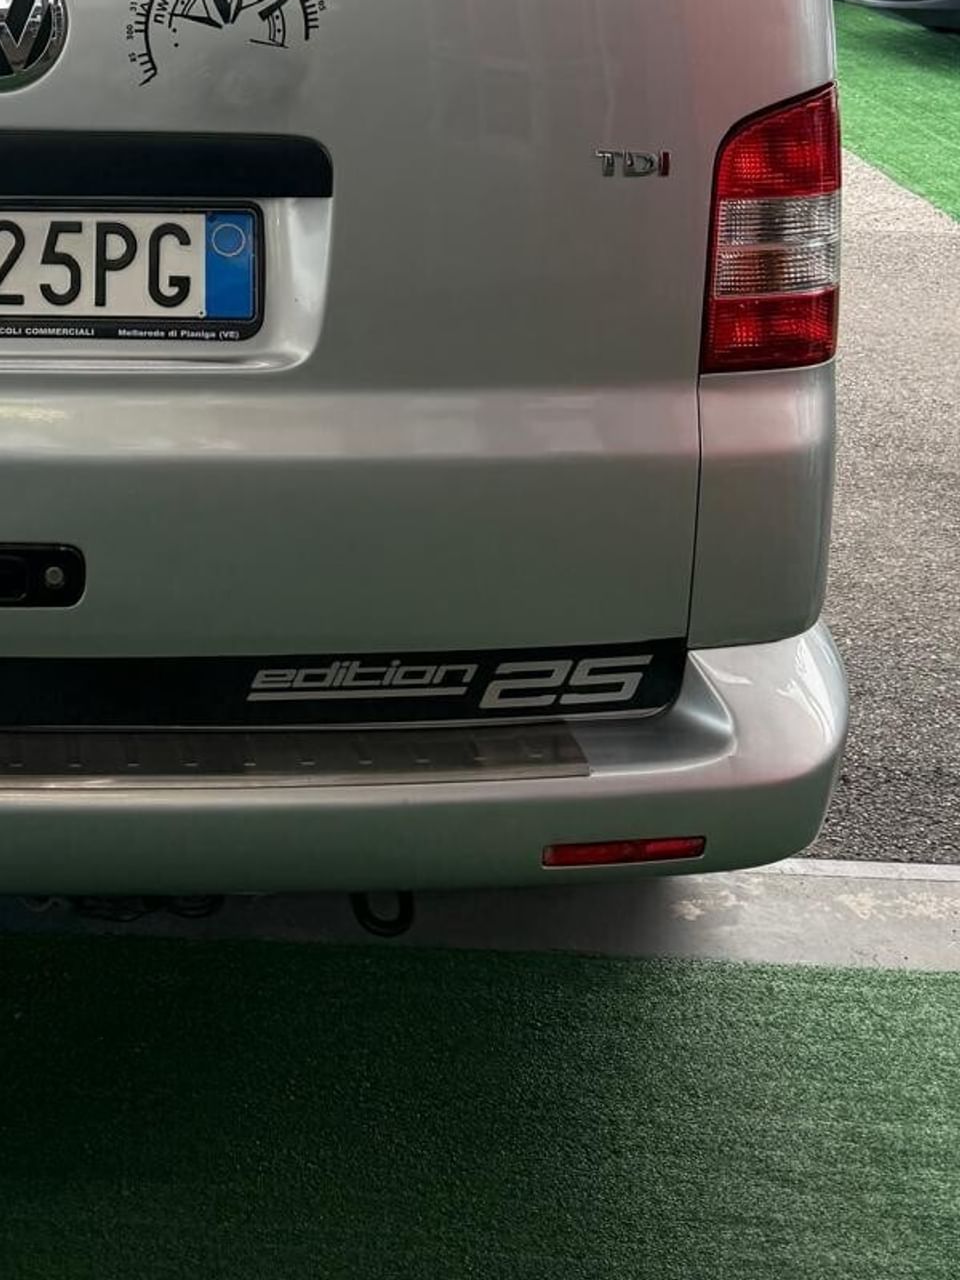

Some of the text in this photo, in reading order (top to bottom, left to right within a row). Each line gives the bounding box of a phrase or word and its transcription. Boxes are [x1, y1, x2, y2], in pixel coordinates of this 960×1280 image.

[595, 151, 670, 178] TDI
[25, 327, 96, 337] COMMERCIALI
[168, 329, 178, 338] di
[219, 330, 241, 340] (VE)
[251, 654, 654, 710] edition 25
